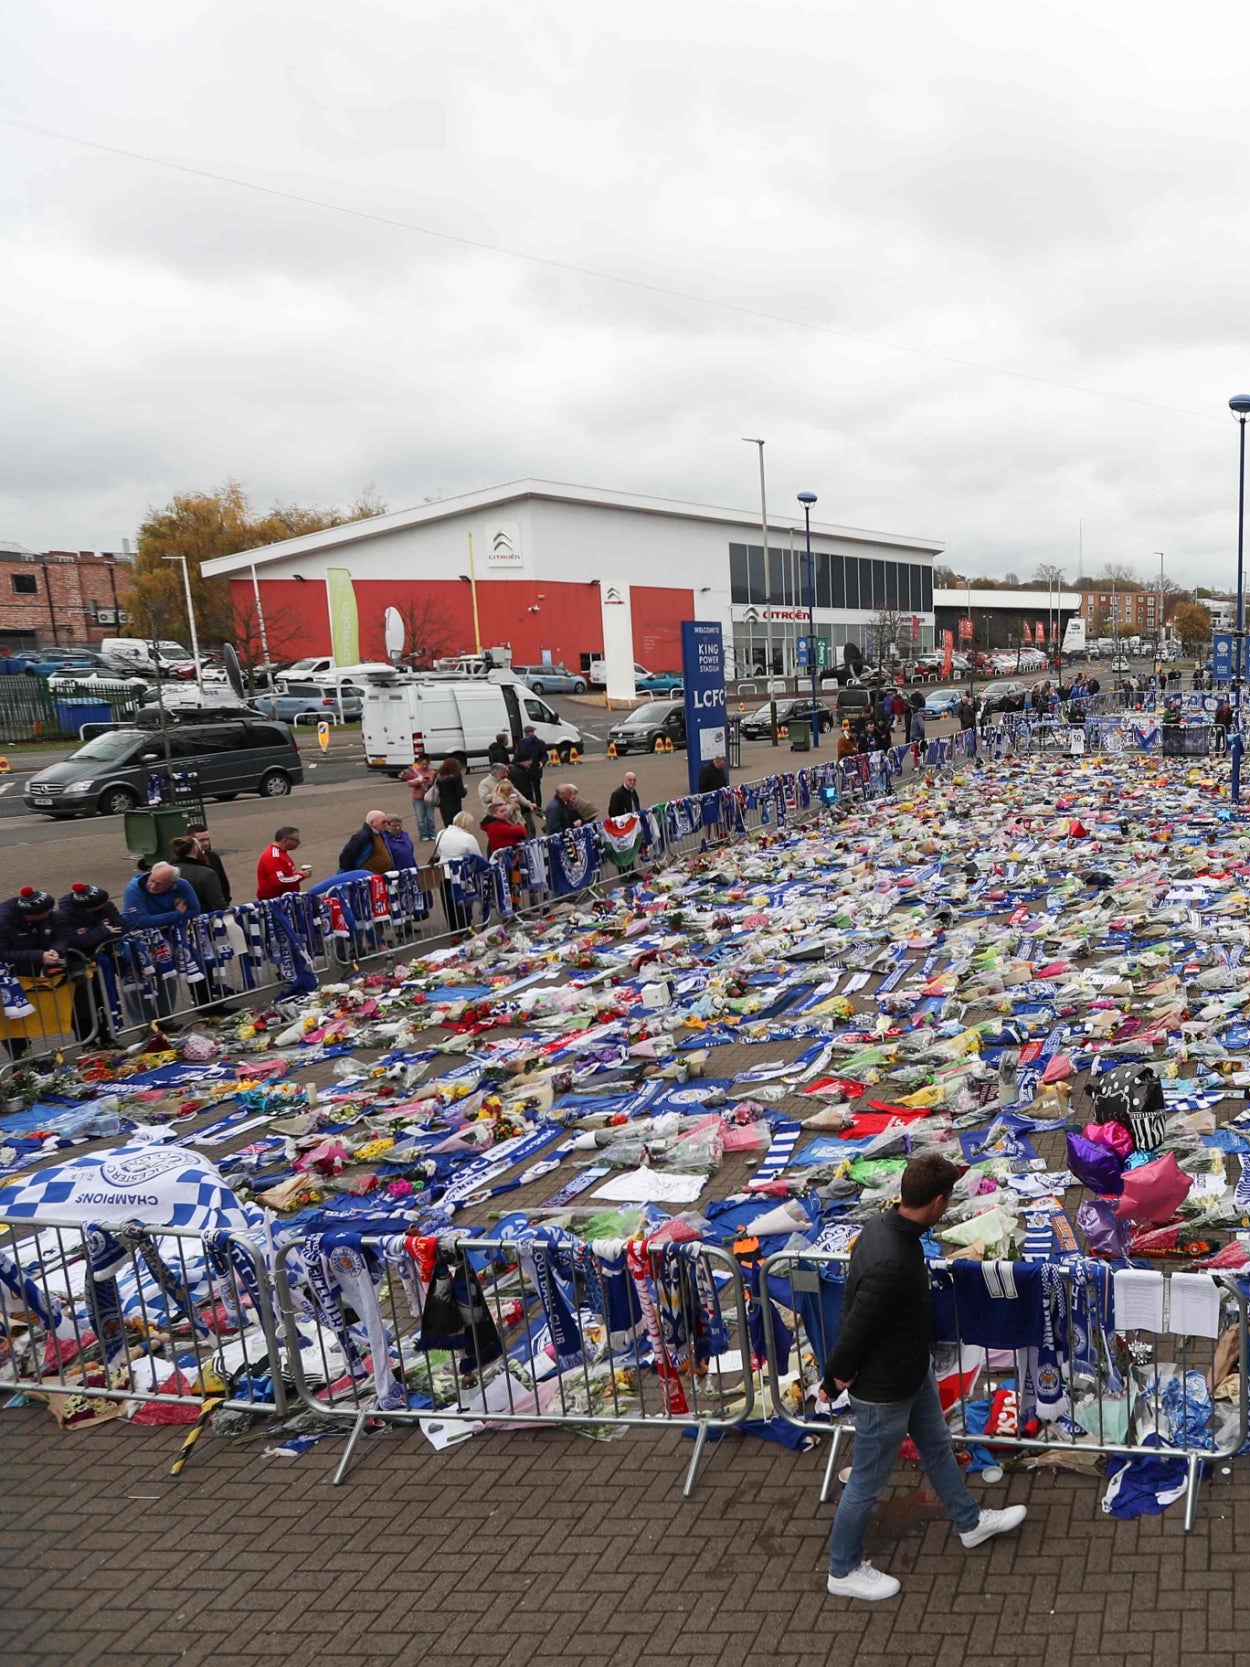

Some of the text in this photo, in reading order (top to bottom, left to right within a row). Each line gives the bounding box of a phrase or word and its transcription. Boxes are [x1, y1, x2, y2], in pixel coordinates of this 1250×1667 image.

[699, 644, 718, 655] KING
[699, 656, 719, 665] POWER
[693, 688, 726, 708] LCFC
[75, 1192, 159, 1206] CHAMPIONS
